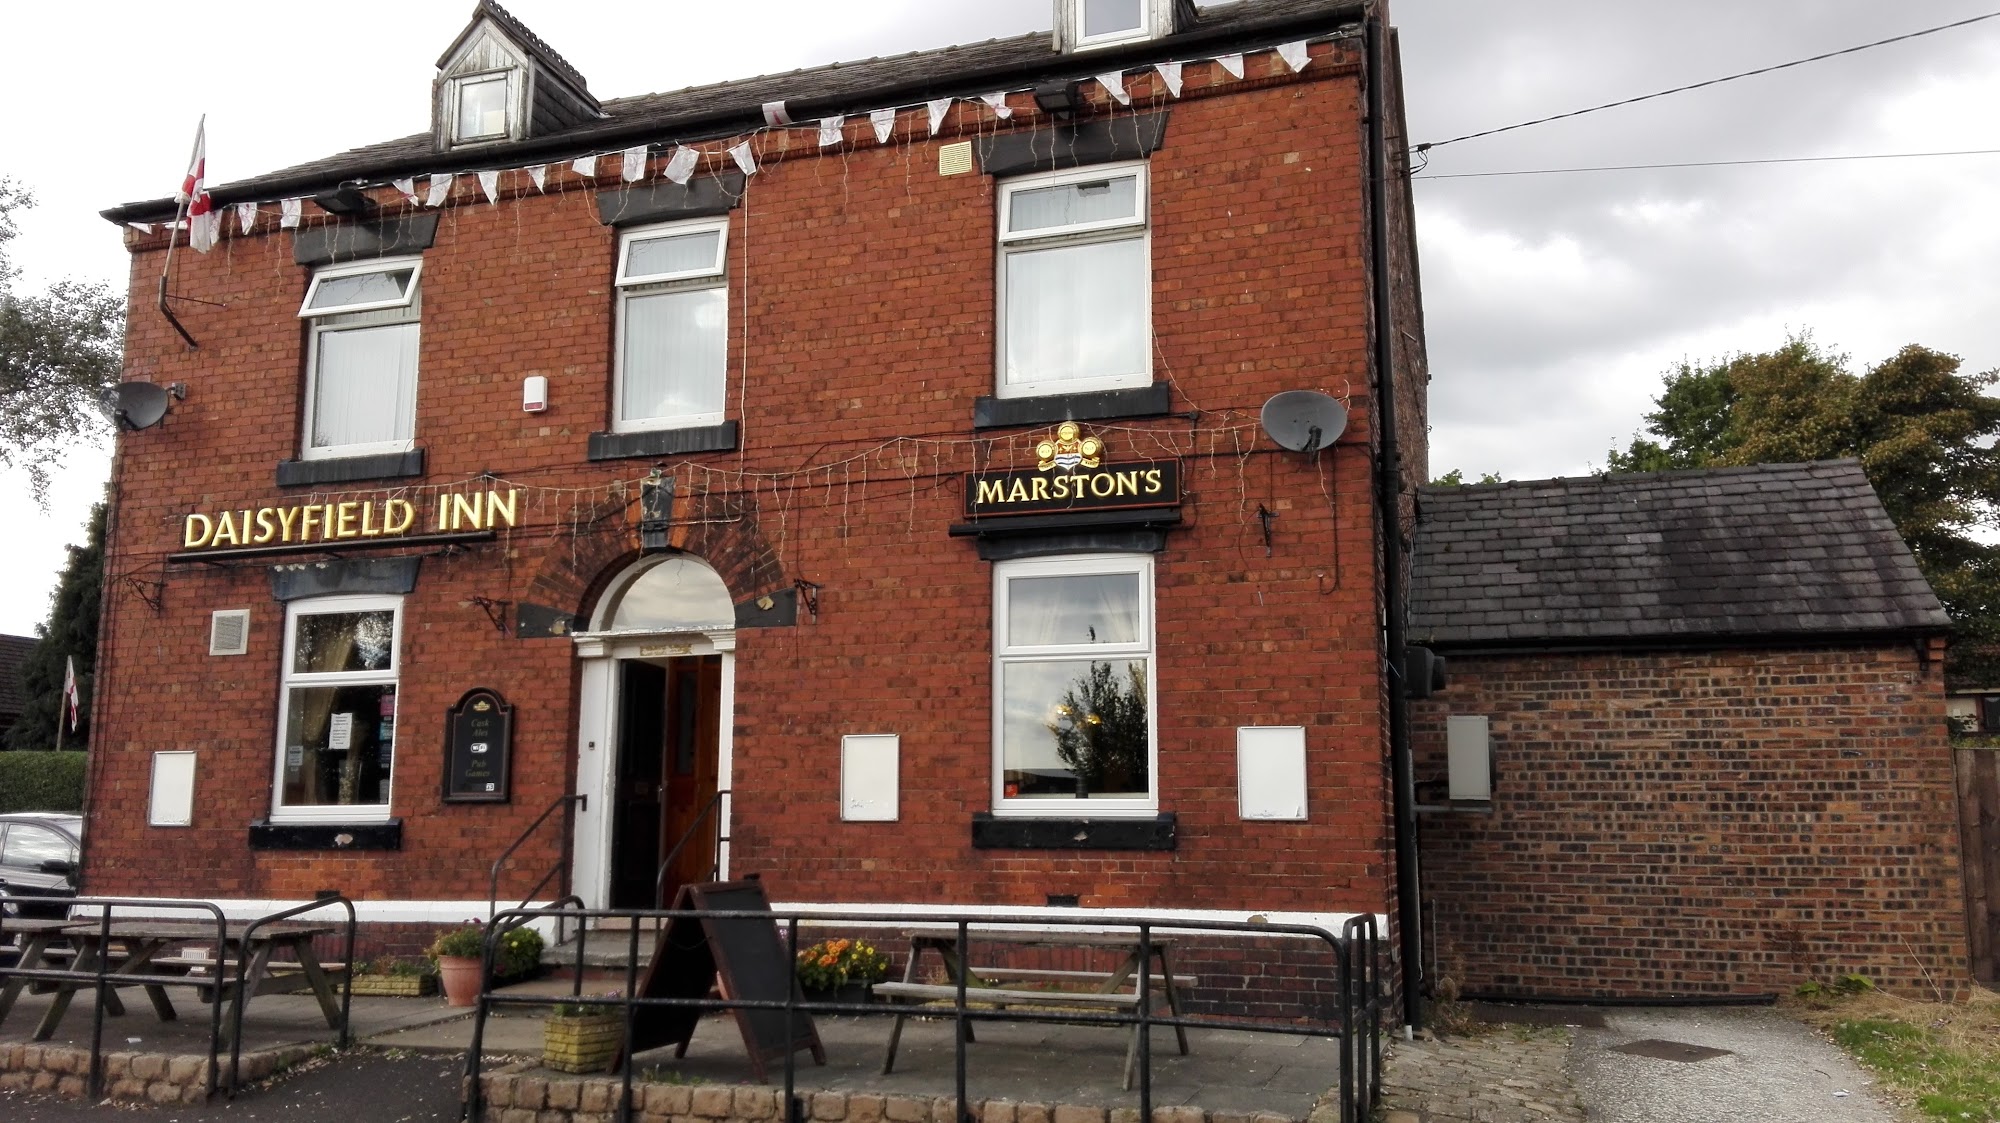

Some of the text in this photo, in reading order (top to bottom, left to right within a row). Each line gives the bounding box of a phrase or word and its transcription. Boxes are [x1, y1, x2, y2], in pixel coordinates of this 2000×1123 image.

[977, 470, 1162, 504] MARSTON'S
[184, 489, 517, 549] DAISYFIELD INN
[471, 719, 490, 728] Cask
[471, 759, 487, 768] Pub
[465, 769, 490, 777] Games
